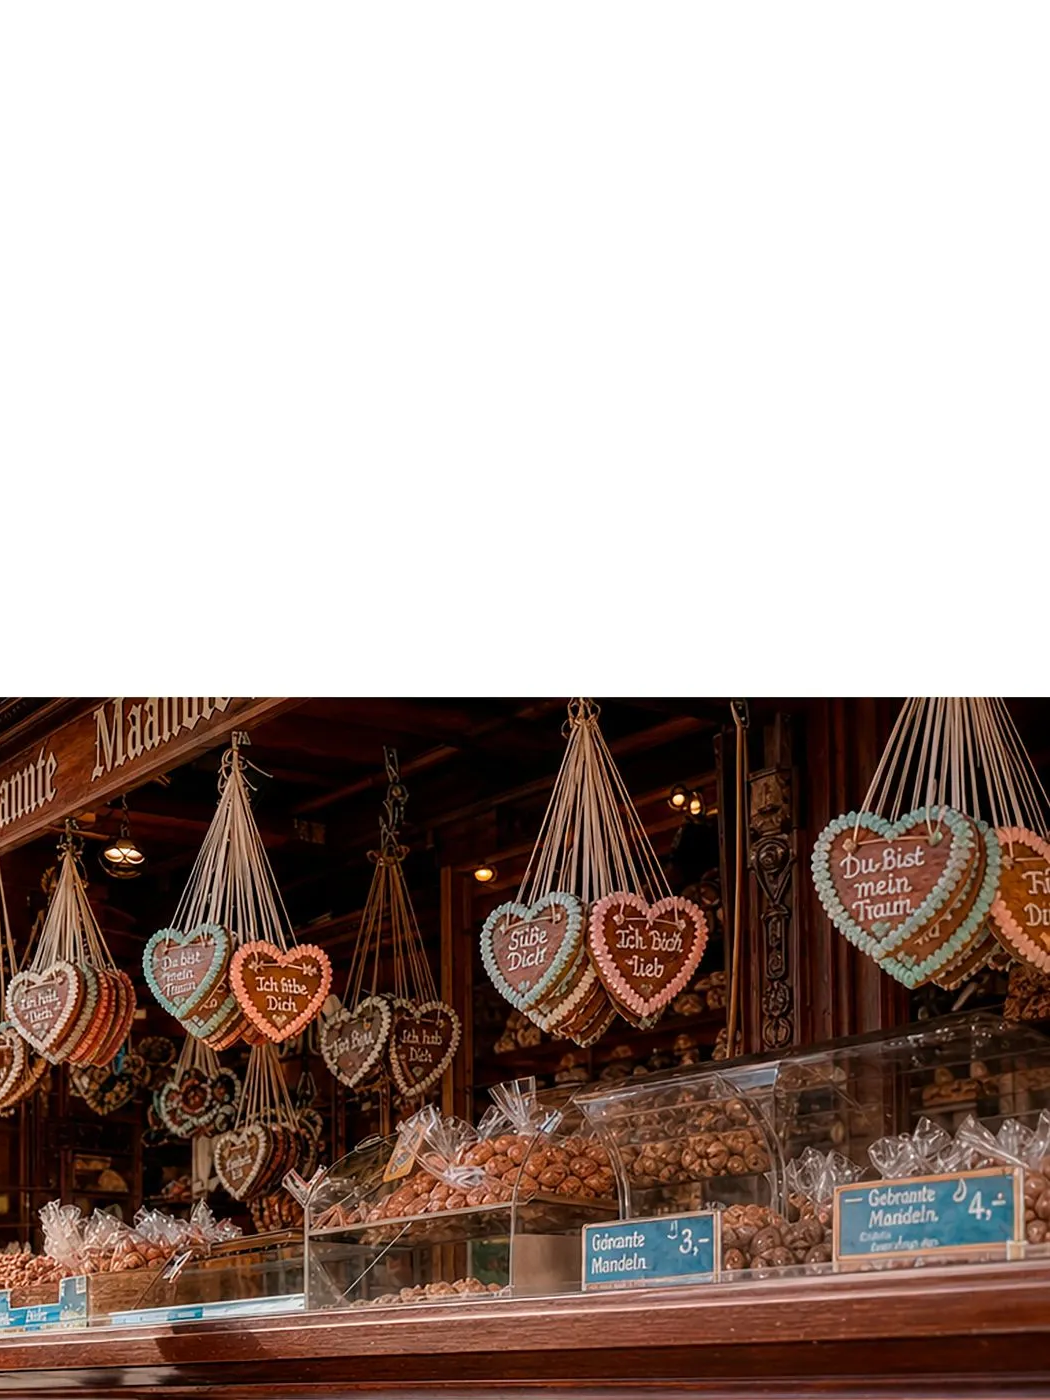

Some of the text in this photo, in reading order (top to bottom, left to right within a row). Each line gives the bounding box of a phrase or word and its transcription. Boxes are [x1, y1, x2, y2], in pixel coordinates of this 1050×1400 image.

[839, 852, 882, 879] Du
[853, 873, 913, 898] mein
[615, 923, 647, 950] Ich
[255, 976, 279, 992] Ich
[266, 994, 298, 1013] Dich
[591, 1252, 648, 1275] Mandeln
